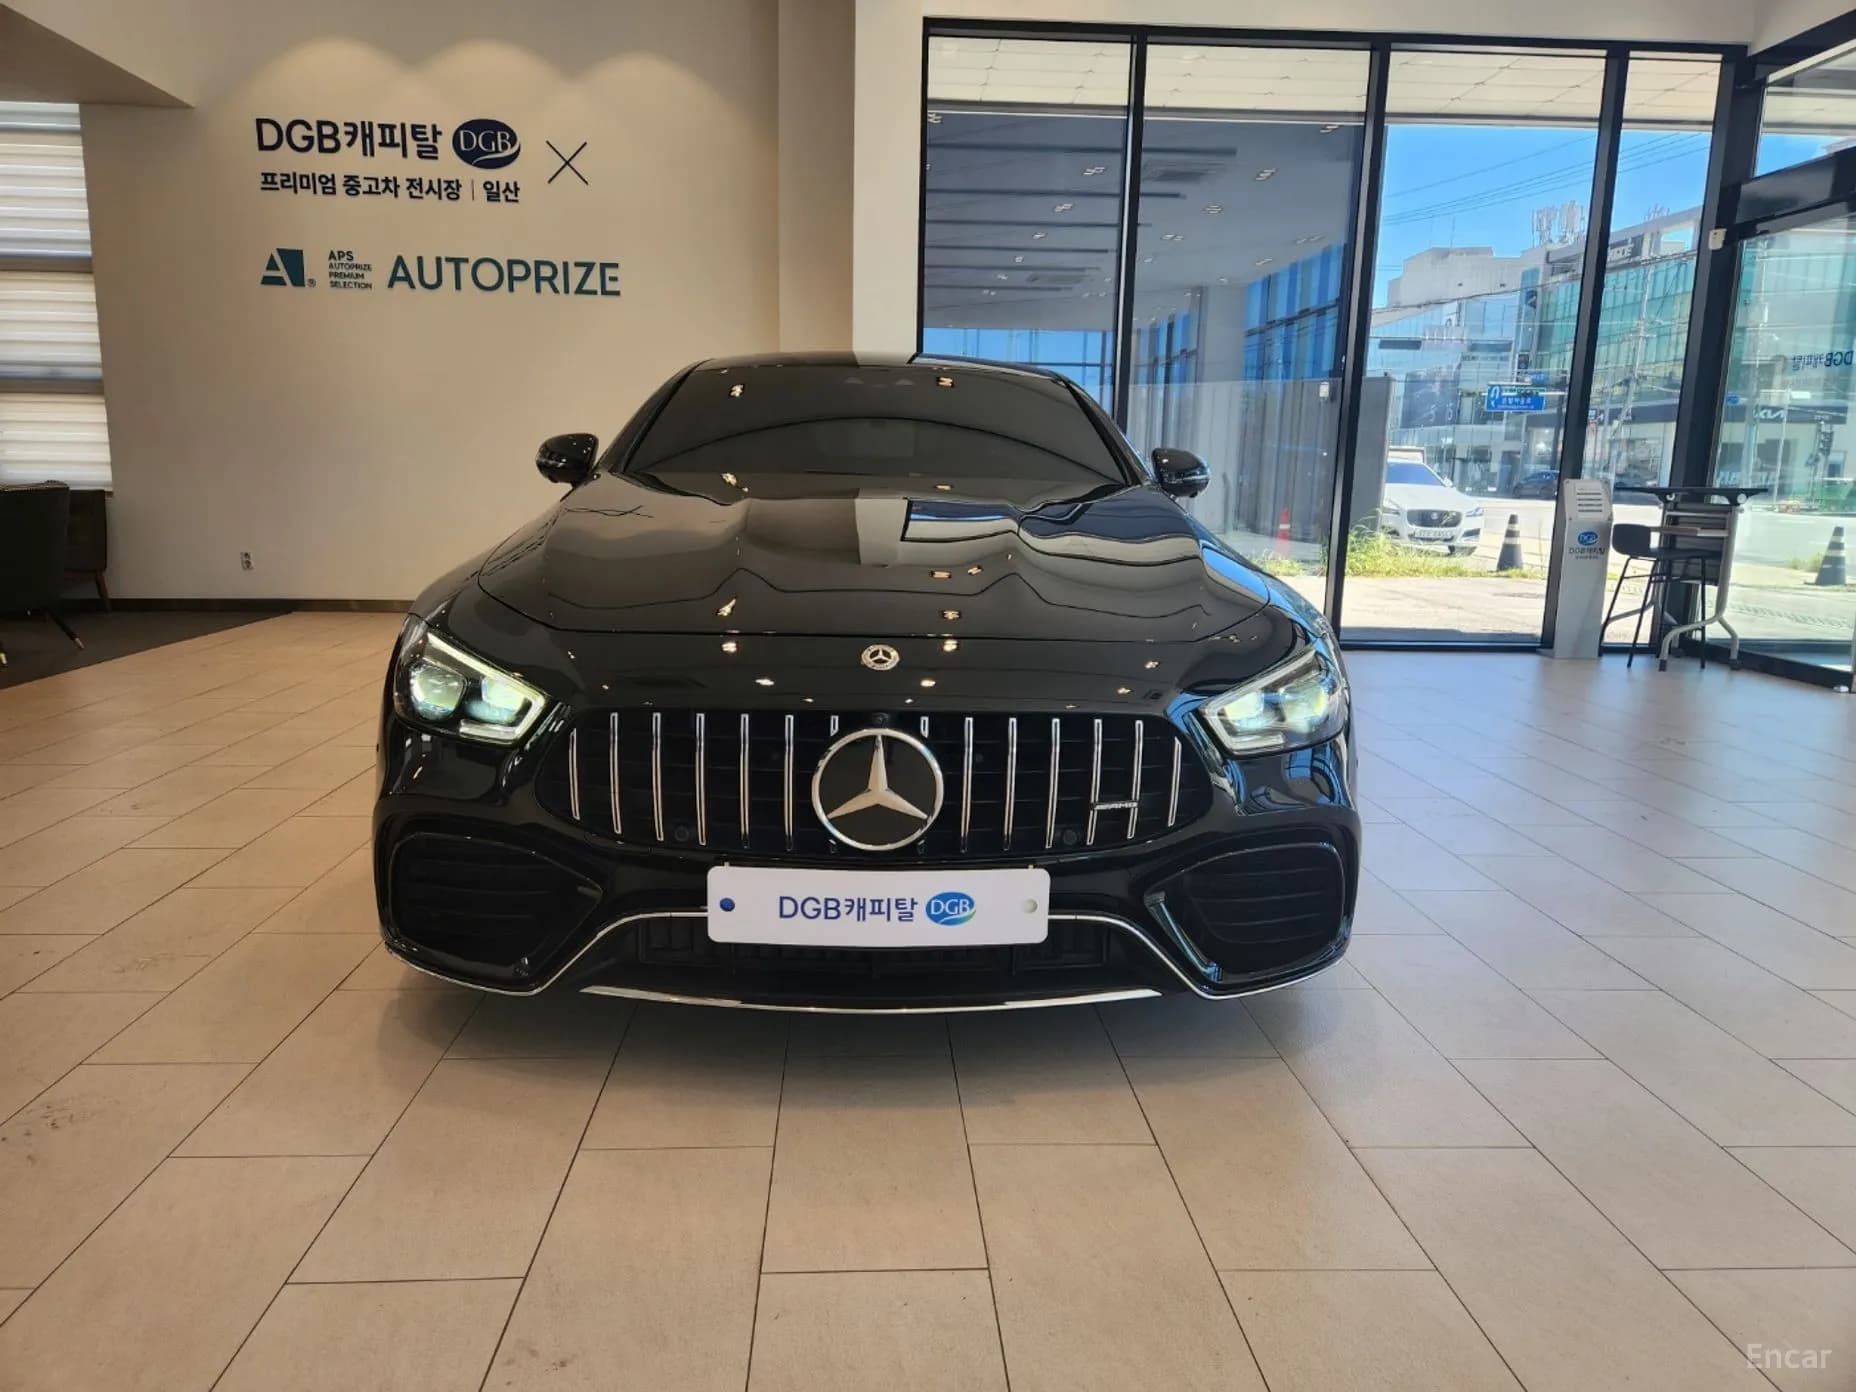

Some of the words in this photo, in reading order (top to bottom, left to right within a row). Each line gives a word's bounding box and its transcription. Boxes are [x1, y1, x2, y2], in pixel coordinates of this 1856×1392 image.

[256, 117, 442, 160] DGB캐피탈
[458, 128, 512, 154] DGB
[260, 172, 337, 195] 프리미엄
[342, 175, 400, 198] 중고차
[405, 177, 462, 200] 전시장
[482, 180, 520, 203] 일산
[328, 250, 354, 261] APS
[328, 262, 372, 272] AUTOPRIZE
[328, 271, 365, 280] PREMIUM
[387, 254, 622, 297] AUTOPRIZE
[330, 280, 373, 290] SELECTION
[779, 896, 918, 922] DGB캐피탈
[930, 899, 971, 916] DGB
